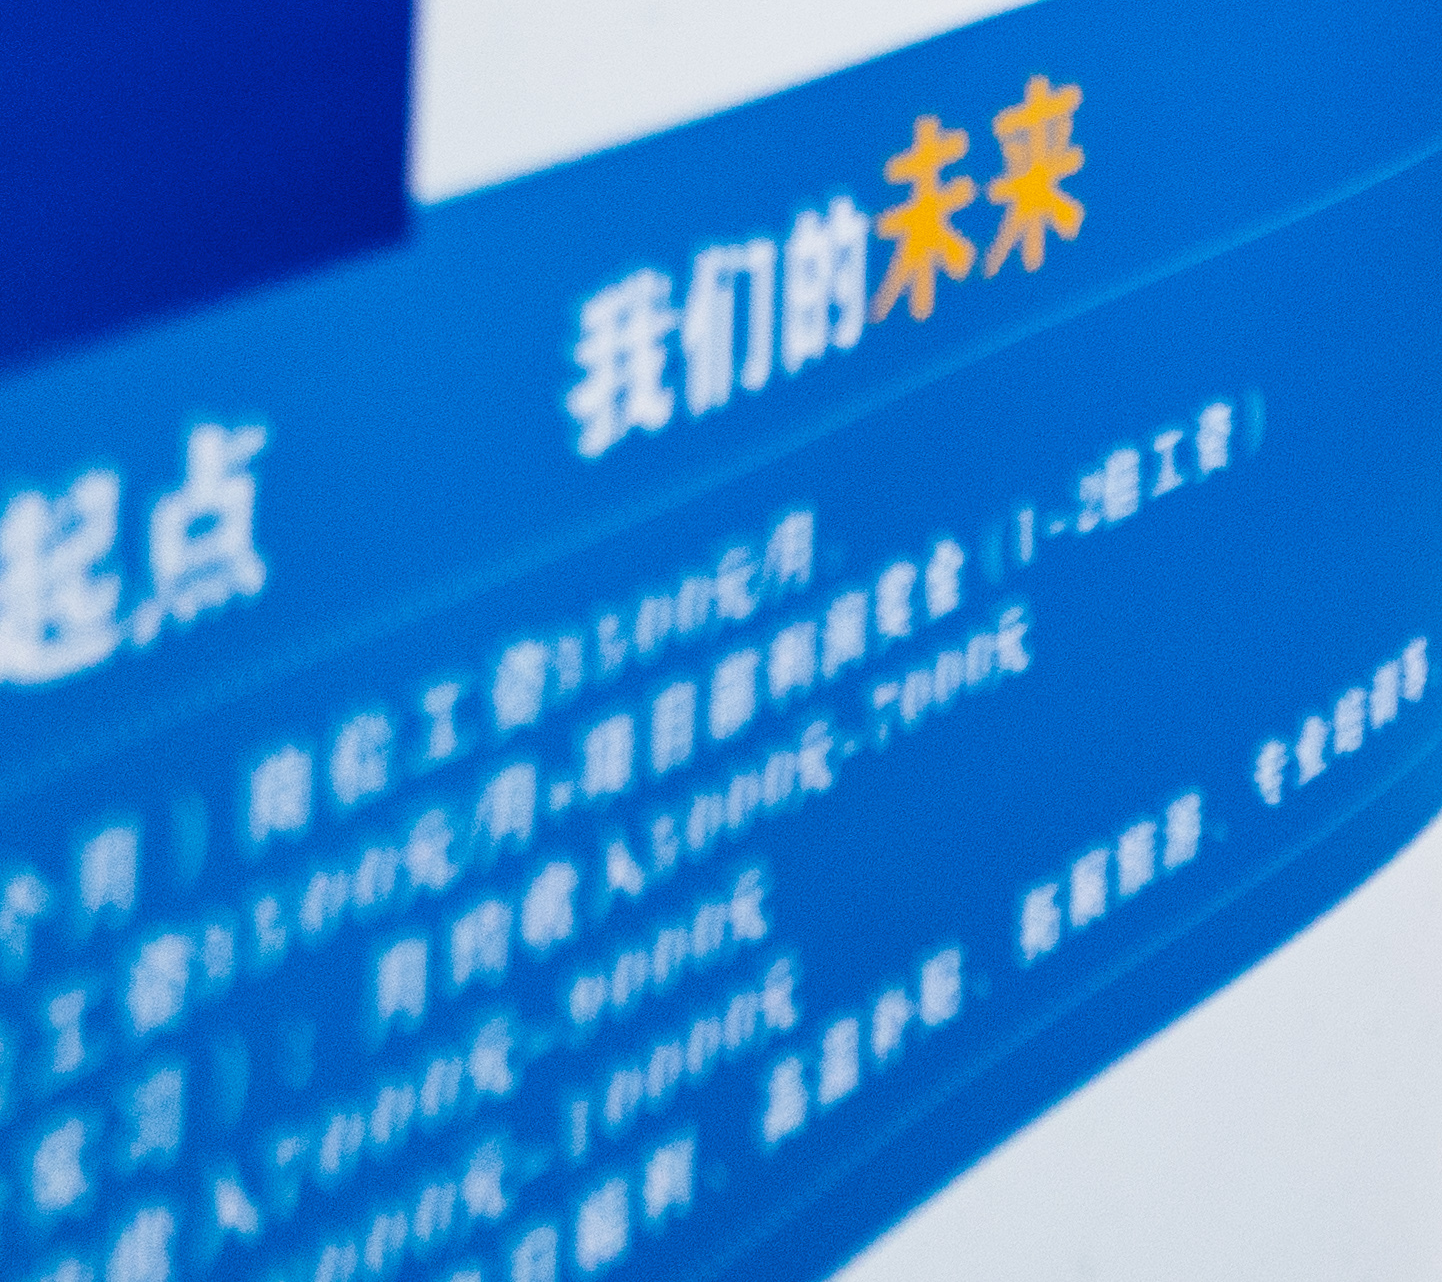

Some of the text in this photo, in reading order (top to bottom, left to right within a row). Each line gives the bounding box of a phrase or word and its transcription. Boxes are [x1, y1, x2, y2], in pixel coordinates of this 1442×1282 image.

[567, 75, 1087, 458] 我们的未来
